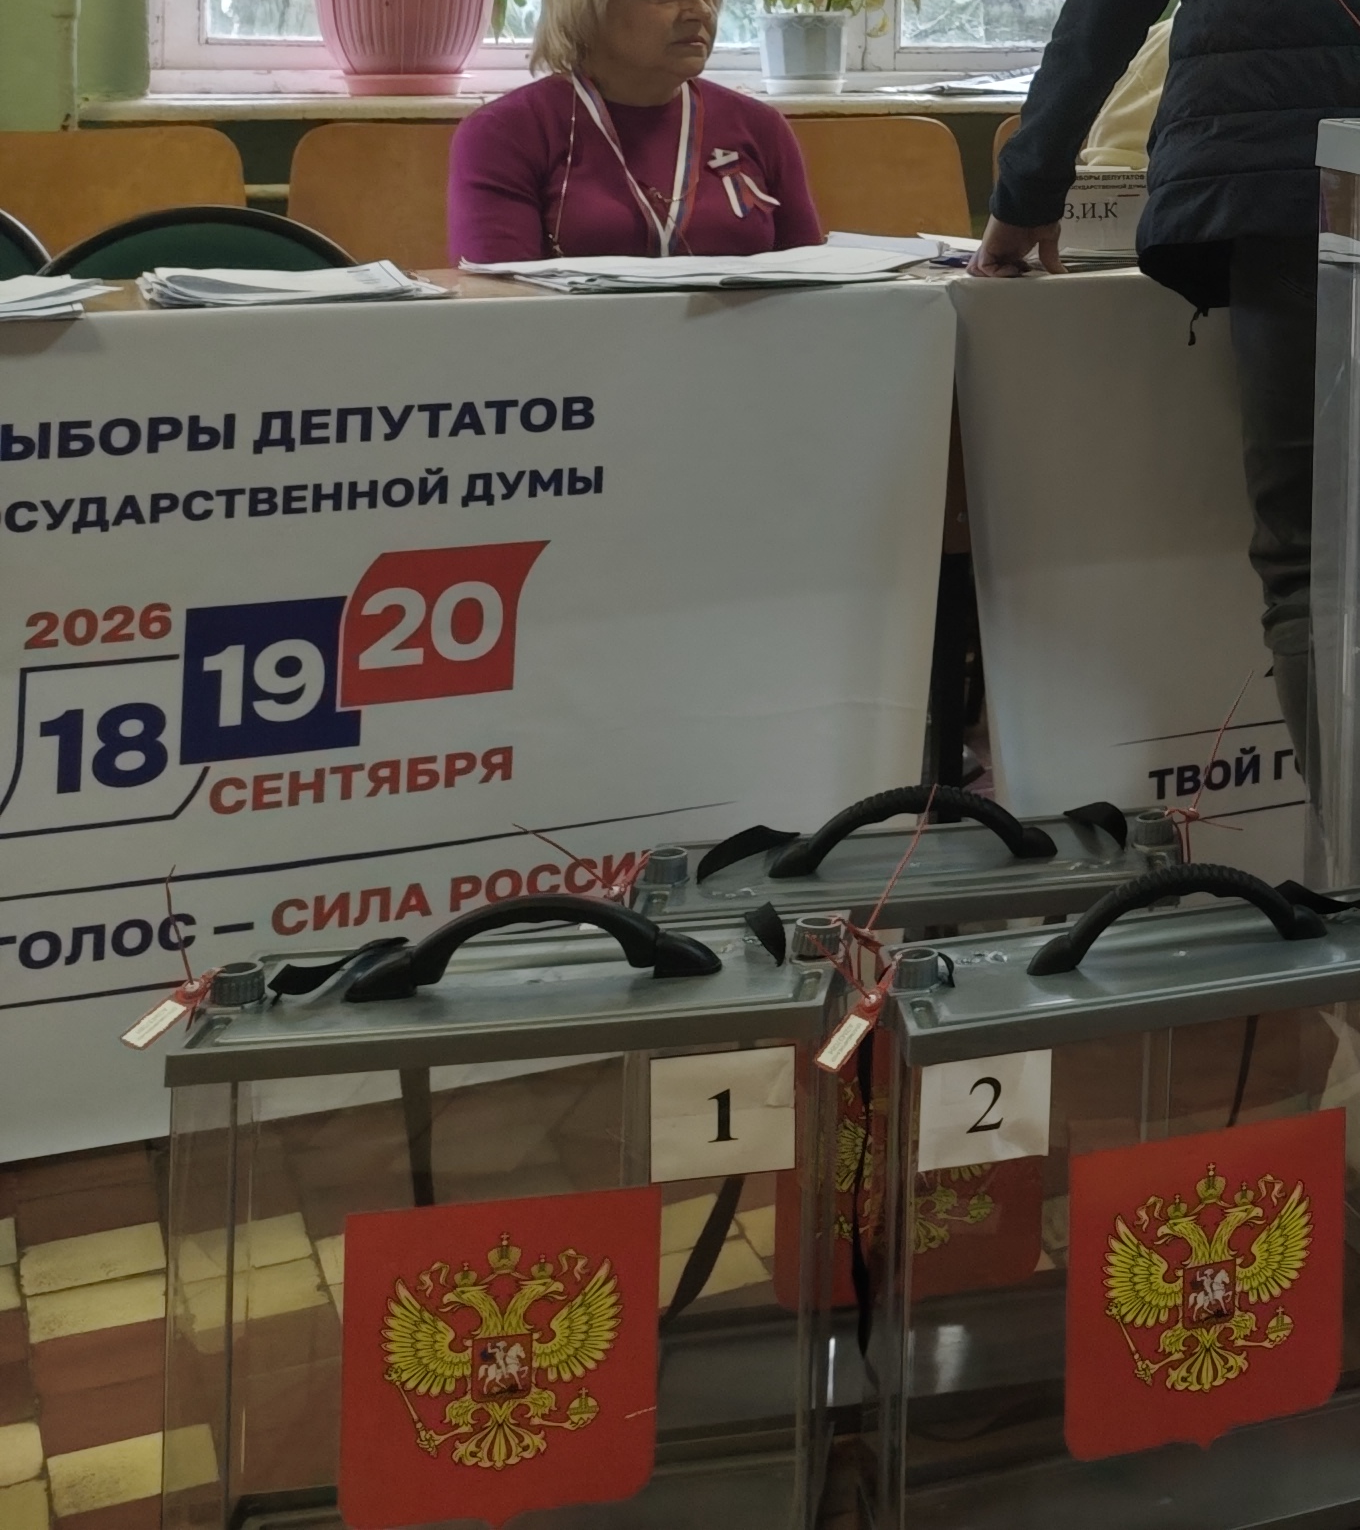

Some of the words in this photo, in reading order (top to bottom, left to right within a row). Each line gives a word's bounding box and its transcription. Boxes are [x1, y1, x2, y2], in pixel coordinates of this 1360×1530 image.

[0, 413, 236, 462] ЫБОРЫ
[252, 396, 595, 455] ДЕПУТАТОВ
[0, 467, 449, 535] СУДАРСТВЕННОЙ
[461, 466, 604, 508] ДУМЫ
[24, 602, 173, 650] 2026
[39, 702, 168, 795] 18
[202, 638, 325, 728] 19
[358, 581, 504, 671] 20
[209, 746, 514, 815] СЕНТЯБРЯ
[1148, 746, 1261, 800] ТВОЙ
[1273, 749, 1304, 780] Г
[271, 880, 433, 937] СИЛА
[449, 849, 651, 913] РОССИ
[707, 1088, 739, 1144] 1
[966, 1076, 1005, 1134] 2
